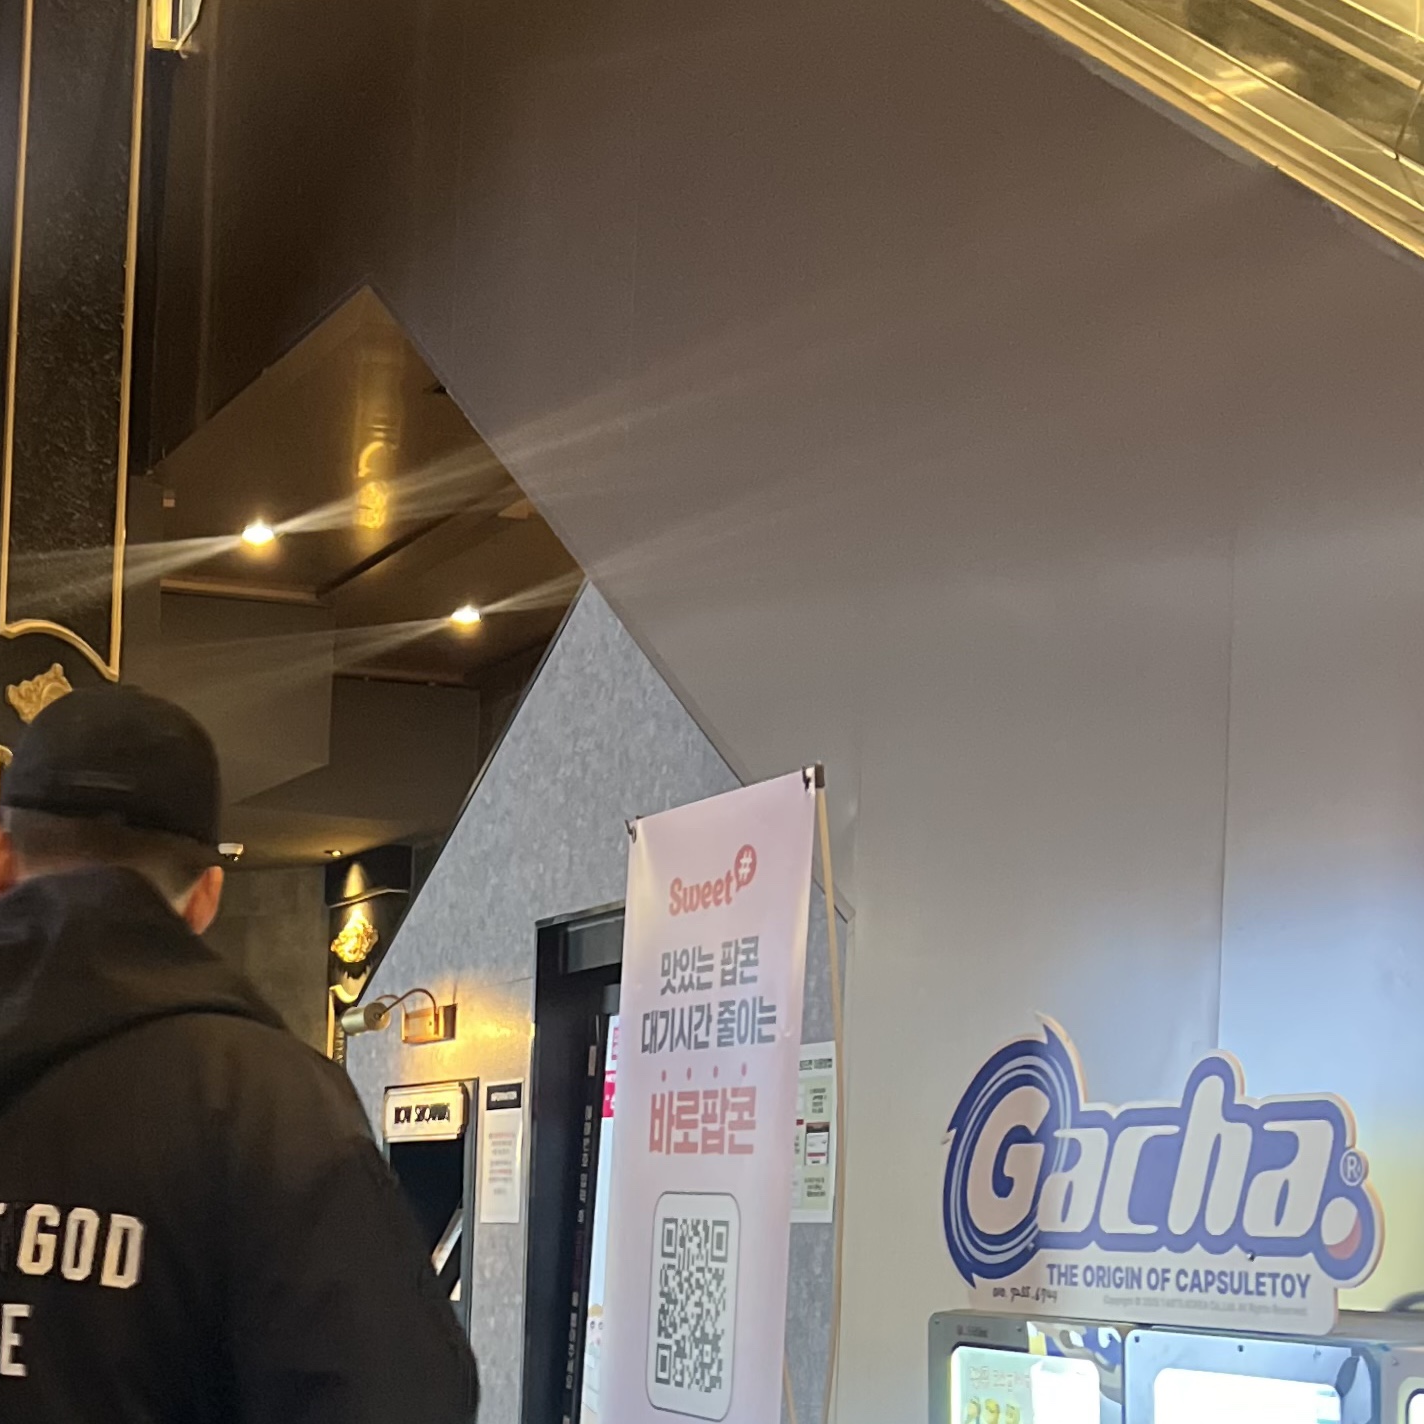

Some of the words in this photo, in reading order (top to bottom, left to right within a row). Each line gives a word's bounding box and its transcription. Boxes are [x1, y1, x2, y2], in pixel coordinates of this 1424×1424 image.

[661, 946, 714, 996] 맛있는
[720, 935, 759, 987] 팝콘
[641, 1002, 712, 1054] 대기시간
[717, 996, 777, 1048] 줄이는
[649, 1085, 757, 1155] 바로팝콘
[16, 1203, 144, 1289] GOD
[1046, 1263, 1079, 1287] THE
[1082, 1265, 1142, 1290] ORIGIN
[1147, 1267, 1171, 1292] OF
[1176, 1268, 1311, 1299] CAPSULETOY
